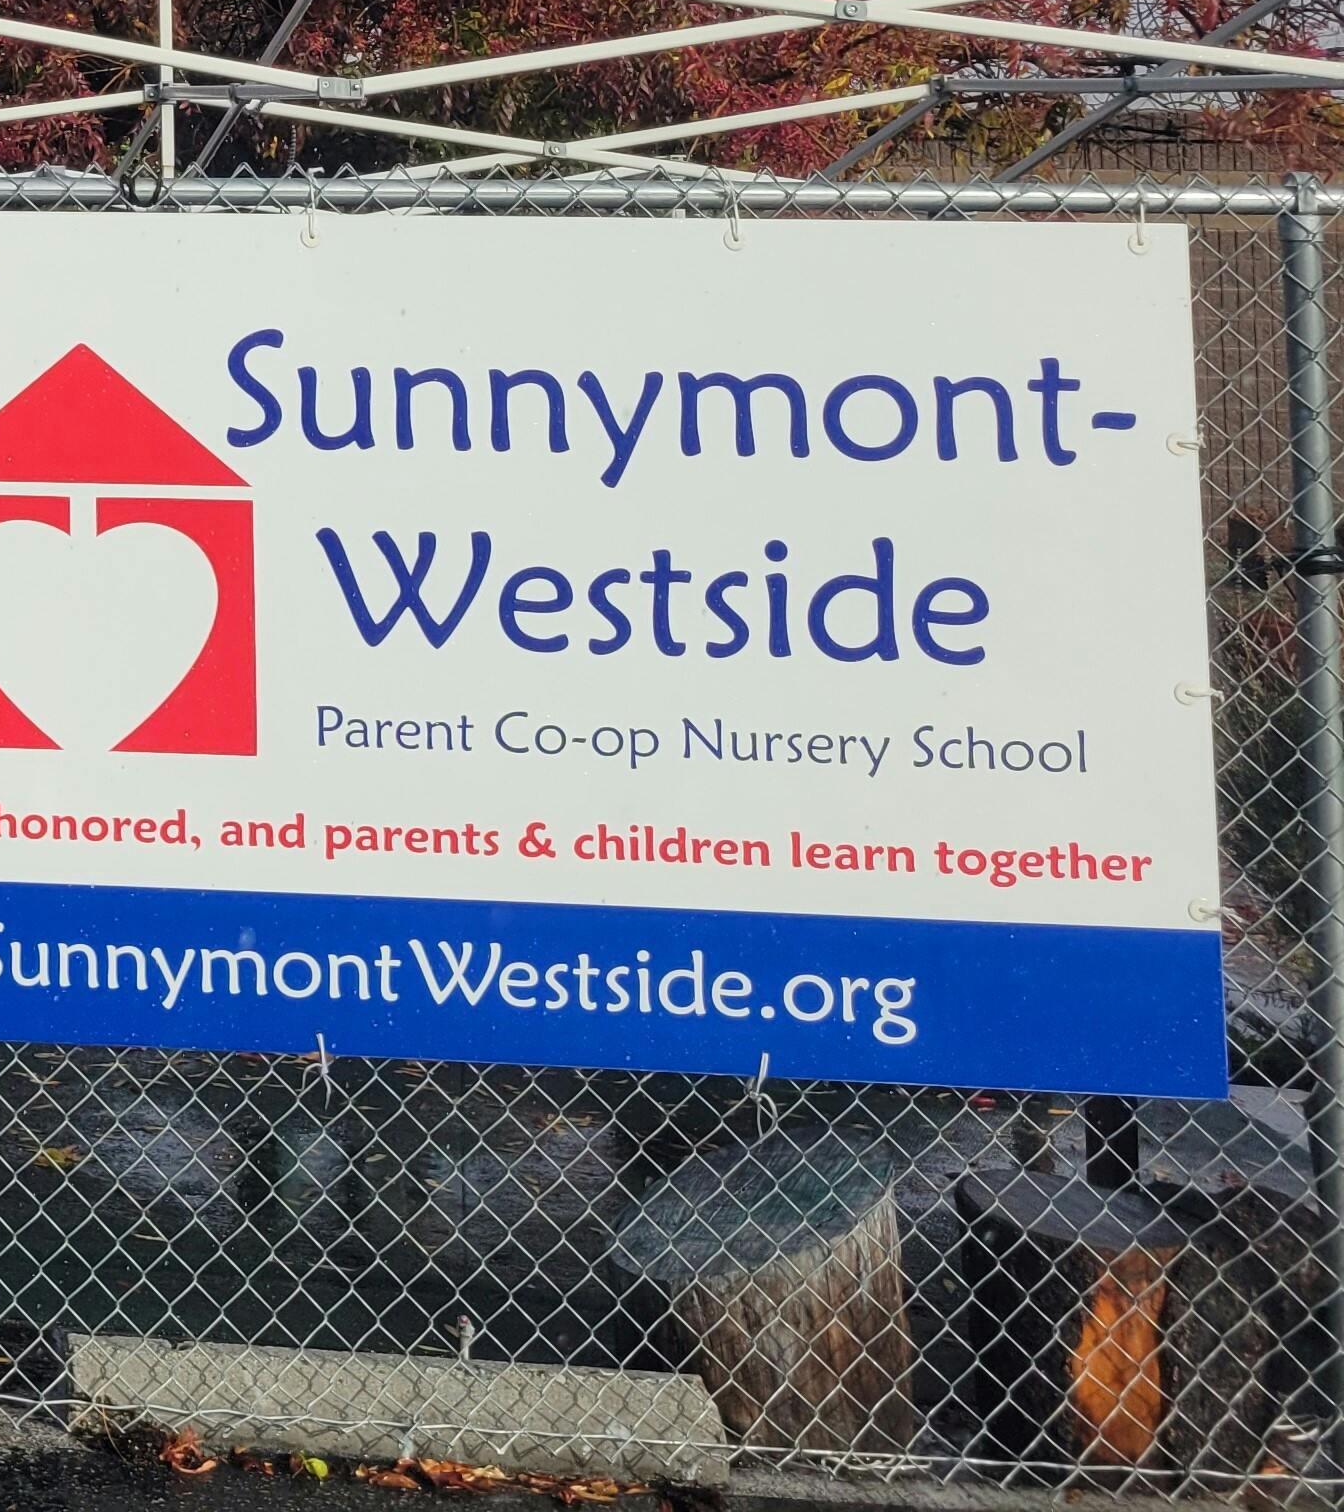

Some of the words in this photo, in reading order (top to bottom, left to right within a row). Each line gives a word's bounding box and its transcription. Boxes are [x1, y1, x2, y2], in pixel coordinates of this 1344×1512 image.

[226, 329, 1137, 488] Sunnymont-
[316, 528, 989, 666] Westside
[316, 705, 475, 752] Parent
[494, 711, 660, 770] Co-op
[681, 717, 891, 778] Nursery
[913, 725, 1087, 773] School
[220, 813, 305, 849] and
[325, 823, 499, 861] parents
[518, 822, 557, 859] &
[574, 824, 770, 866] children
[791, 831, 915, 873] learn
[936, 842, 1152, 888] together
